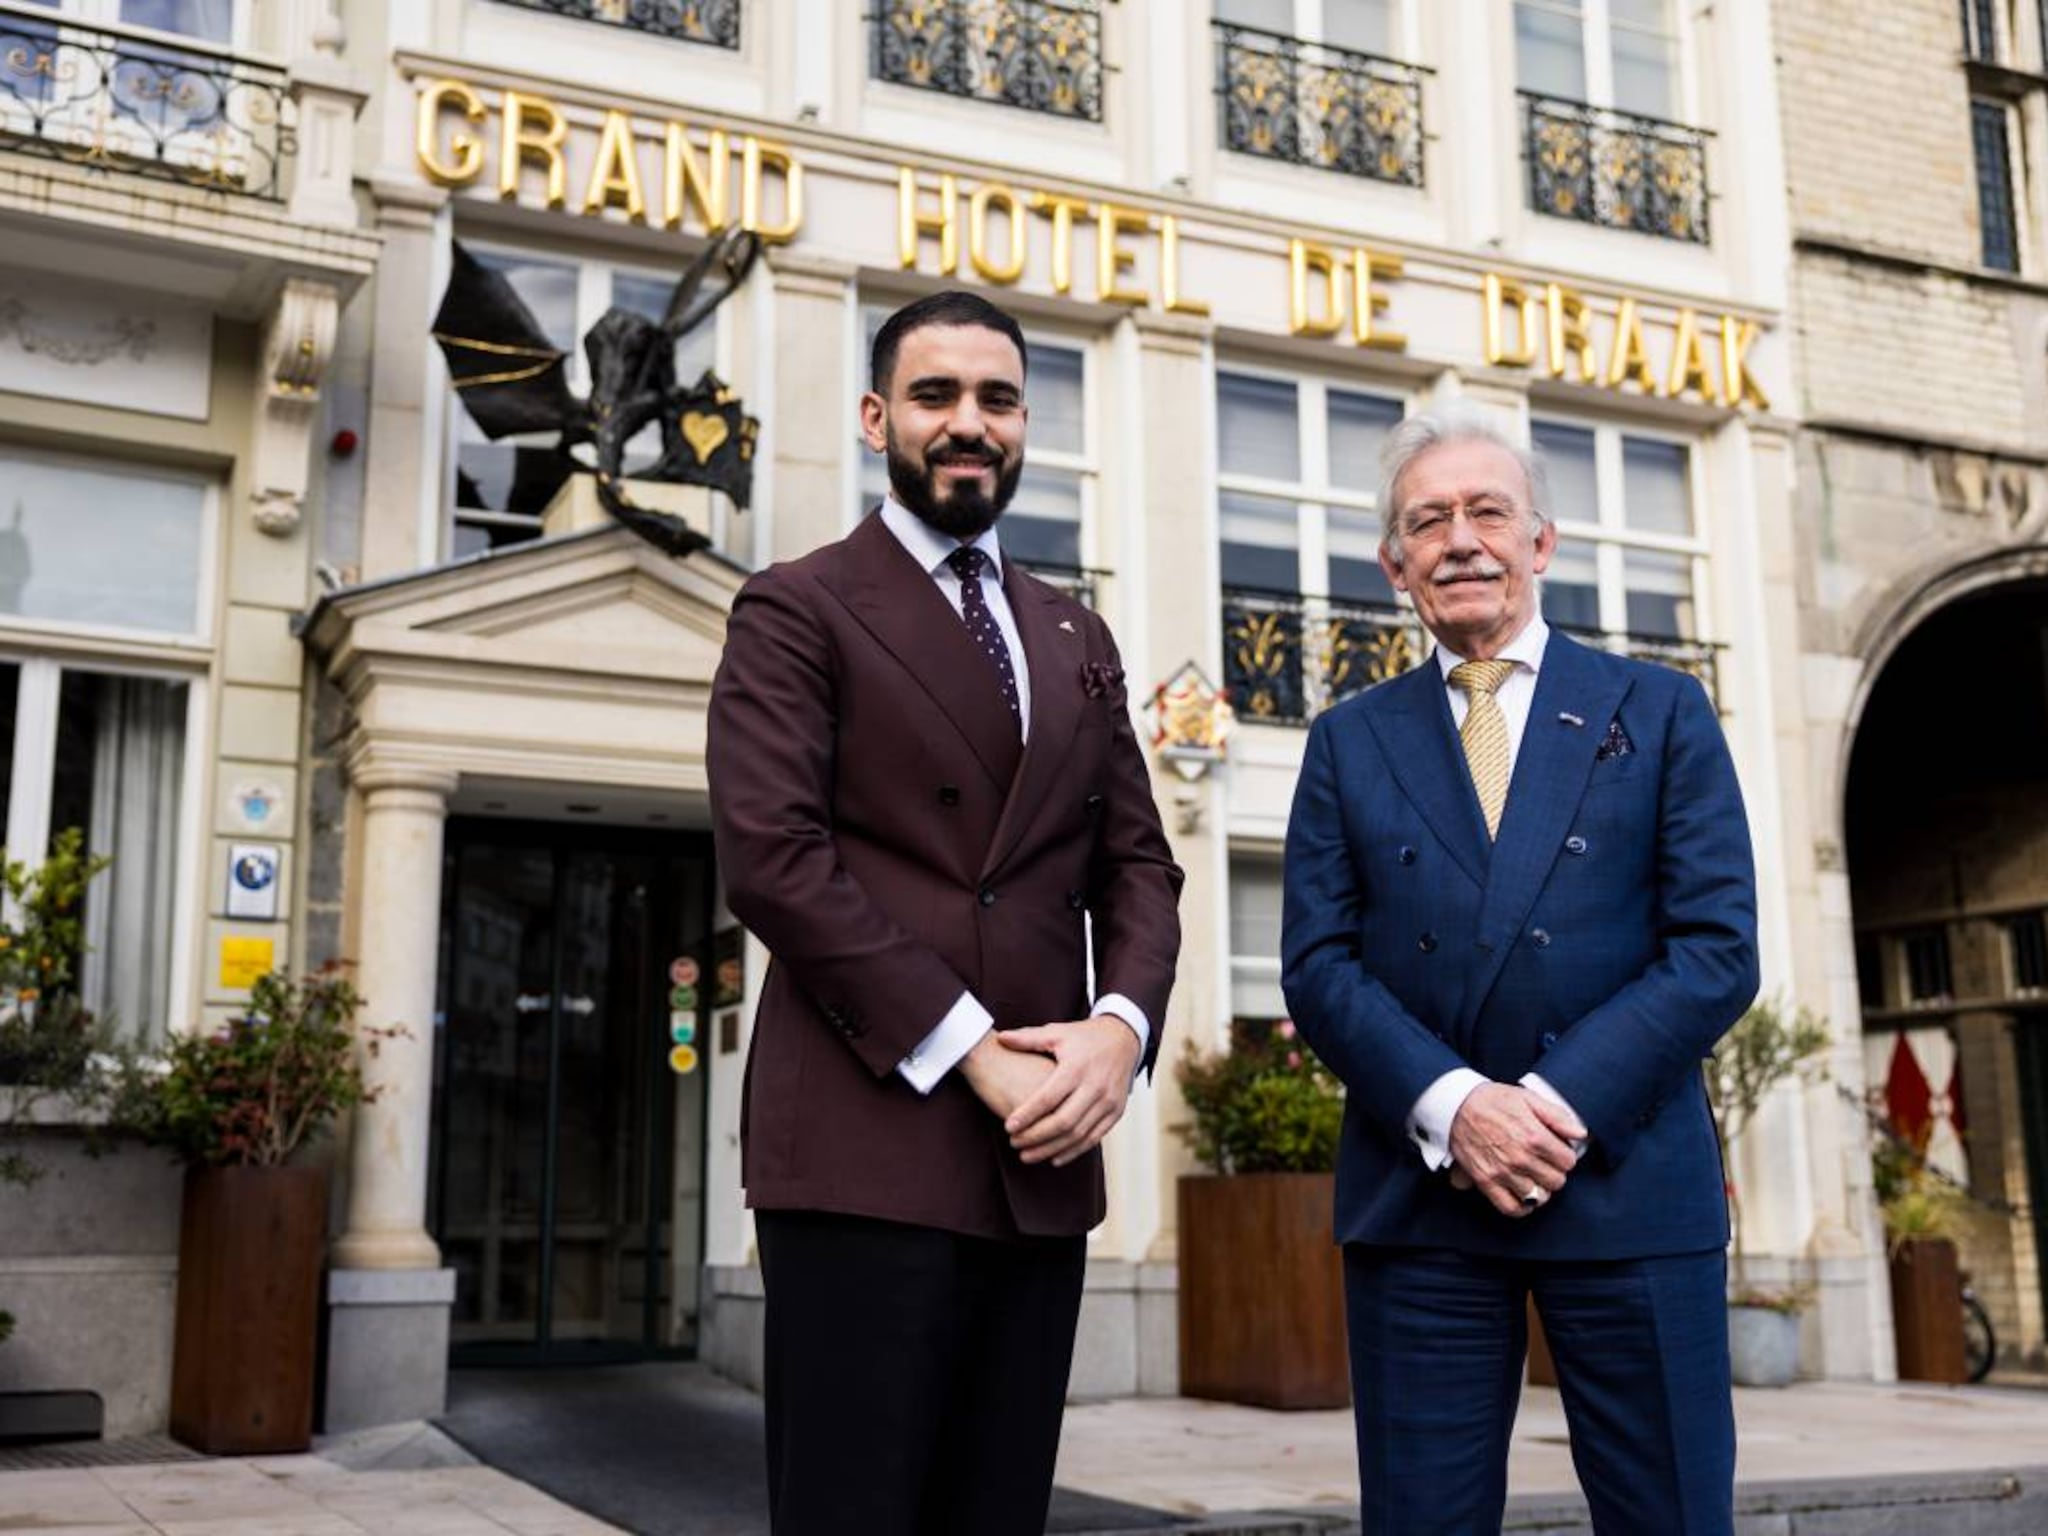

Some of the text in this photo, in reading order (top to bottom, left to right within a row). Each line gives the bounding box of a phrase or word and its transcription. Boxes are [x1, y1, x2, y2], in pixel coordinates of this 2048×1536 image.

[416, 79, 1772, 410] GRAND HOTEL DE DRAAK
